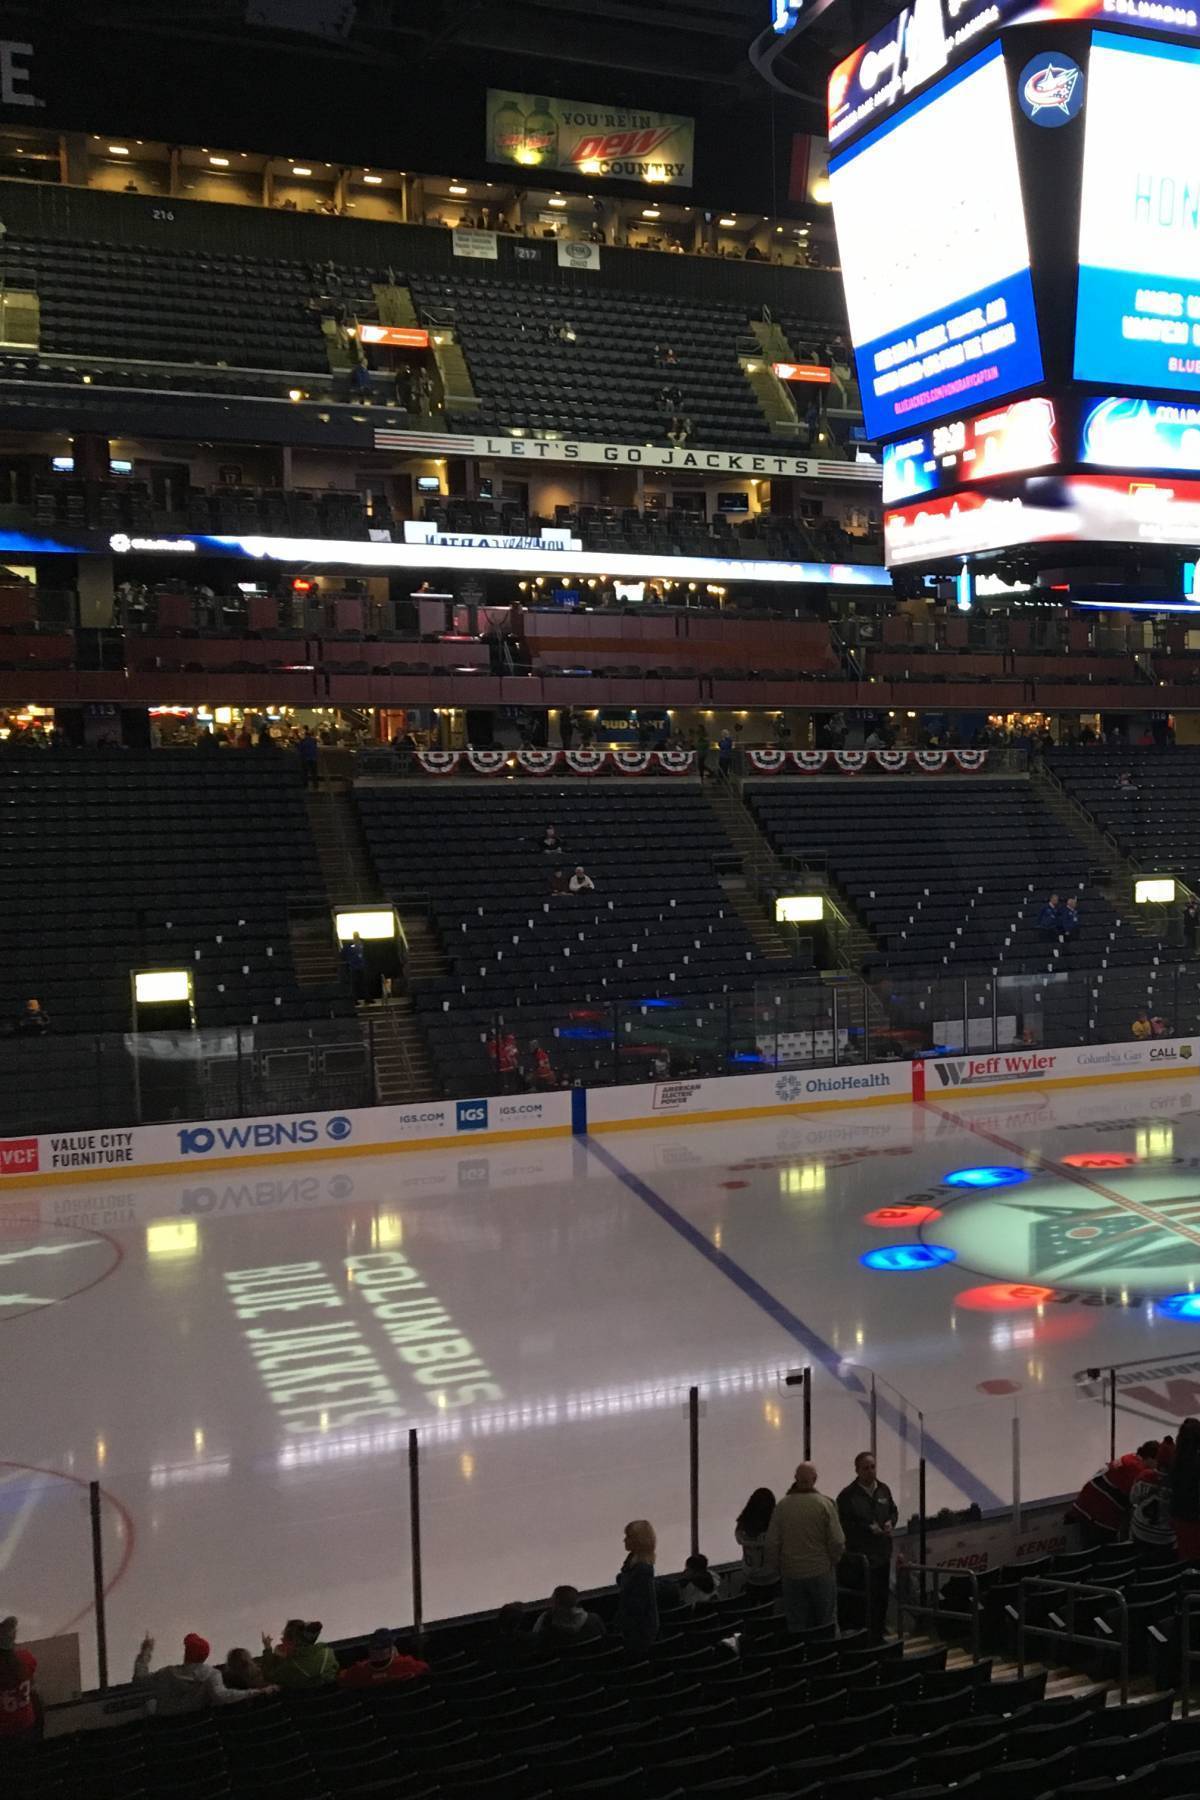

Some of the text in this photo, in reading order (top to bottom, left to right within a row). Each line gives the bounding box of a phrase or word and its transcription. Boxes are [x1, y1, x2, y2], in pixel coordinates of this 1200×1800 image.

[562, 112, 650, 129] YOU'RE IN
[600, 161, 685, 177] COUNTRY
[152, 209, 174, 221] 216
[519, 249, 537, 259] 217
[486, 440, 810, 475] LET'S GO JACKETS
[1150, 1046, 1177, 1058] CALL
[968, 1056, 1002, 1076] Jeff
[1004, 1054, 1057, 1073] Wyler
[805, 1073, 891, 1093] OhioHealth
[400, 1111, 445, 1124] IGS.COM
[460, 1107, 485, 1122] IGS
[500, 1103, 543, 1115] IGS.COM
[50, 1132, 134, 1151] VALUE CITY
[2, 1148, 37, 1165] VCF
[52, 1148, 134, 1168] FURNITURE
[223, 1260, 344, 1320] BLUE
[343, 1250, 505, 1409] COLUMBUS
[244, 1320, 407, 1434] JACKETS
[1015, 1535, 1068, 1558] KENDA
